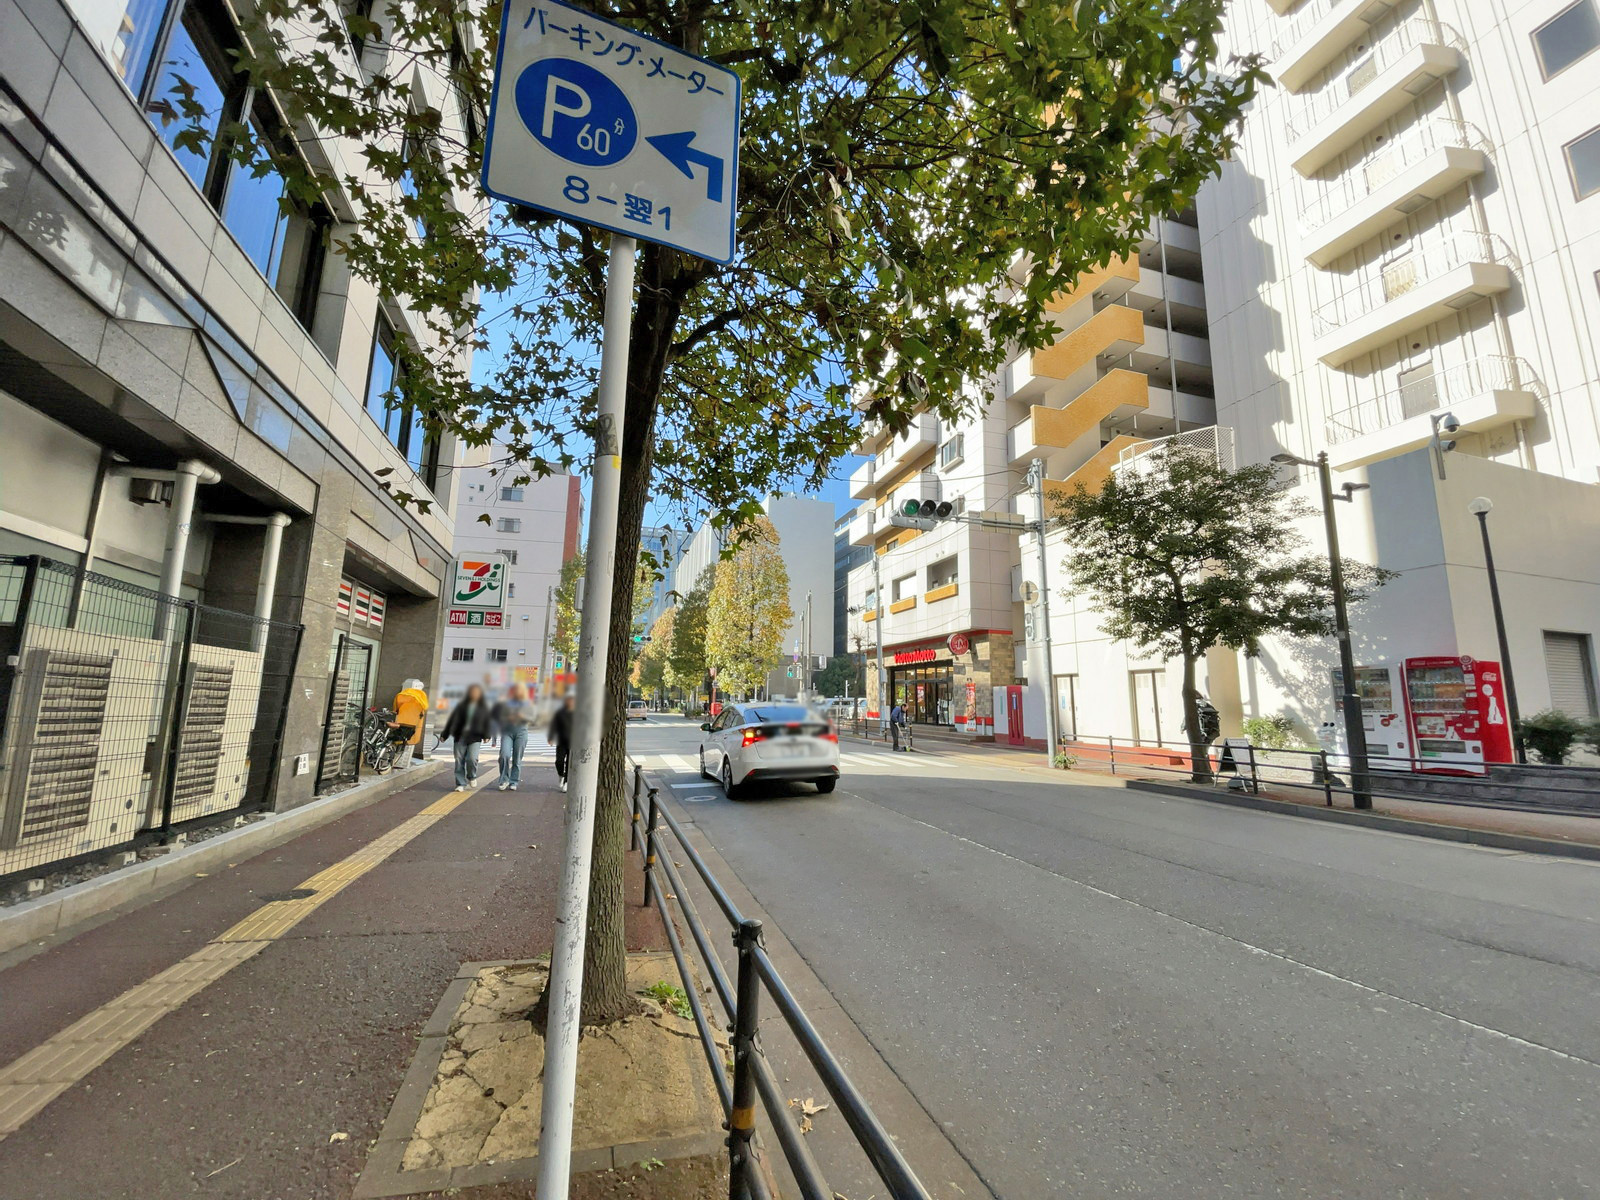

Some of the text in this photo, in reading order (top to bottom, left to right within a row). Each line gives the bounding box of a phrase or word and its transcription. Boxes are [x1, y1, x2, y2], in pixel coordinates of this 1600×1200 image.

[523, 7, 724, 95] パーキング・メーター
[541, 74, 592, 139] P
[450, 612, 466, 623] ATM
[470, 613, 482, 624] 酒
[485, 614, 501, 624] たばこ
